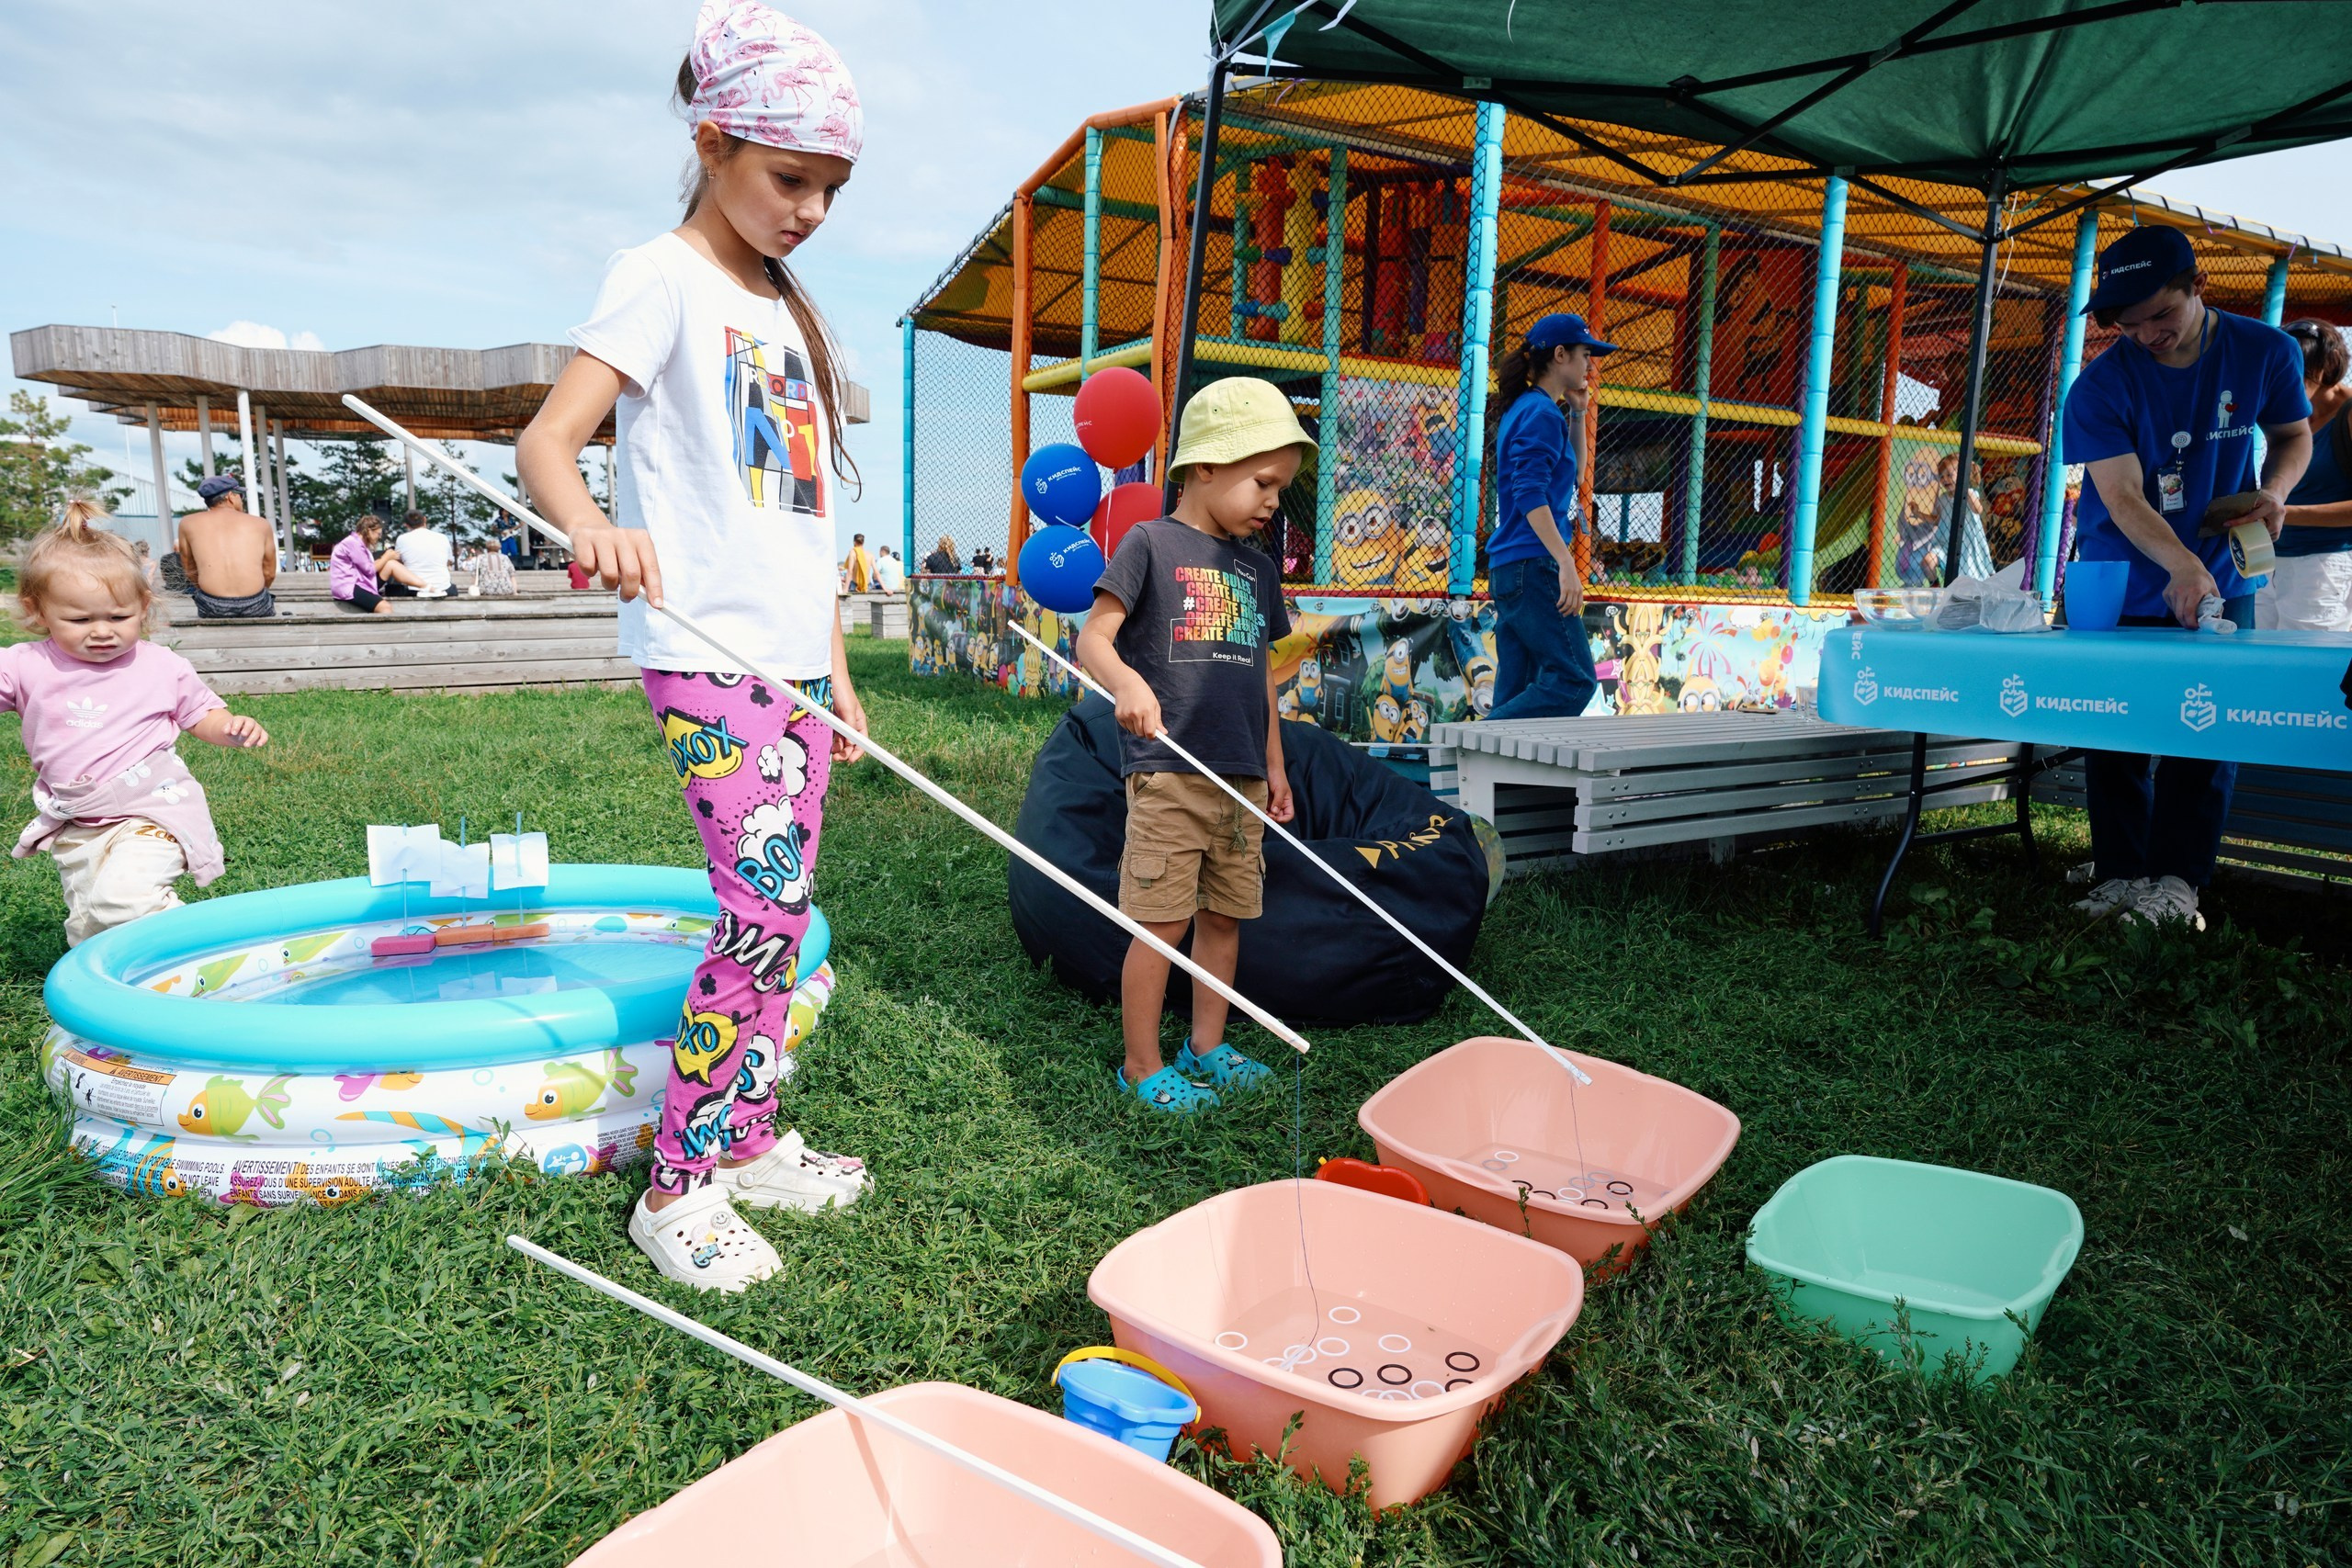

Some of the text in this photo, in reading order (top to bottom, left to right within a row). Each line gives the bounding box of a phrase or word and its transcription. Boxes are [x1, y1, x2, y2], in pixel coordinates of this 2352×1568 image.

[2110, 260, 2152, 275] КИДСПЕЙС
[1175, 566, 1251, 595] CREATE RULES
[1186, 581, 1231, 601] CREATE
[1182, 596, 1239, 616] #CREATE
[1185, 611, 1233, 629] CREATE
[1174, 626, 1258, 649] CREATE RULES
[1851, 630, 1864, 660] ЕЙС
[1213, 651, 1232, 661] Keep
[1237, 655, 1251, 664] Real
[1883, 685, 1960, 703] КИДСПЕЙС
[2035, 695, 2129, 715] КИДСПЕЙС
[65, 719, 104, 729] adidas
[2226, 708, 2348, 730] КИДСПЕЙС
[117, 1068, 165, 1083] AVERTISSEMENT
[147, 1156, 176, 1169] PORTABLE
[175, 1159, 204, 1173] SWIMMING
[203, 1162, 225, 1175] POOLS.
[231, 1159, 301, 1175] AVERTISSEMENT!
[300, 1163, 315, 1175] DES
[314, 1163, 345, 1175] ENFANTS
[345, 1162, 356, 1174] SE
[356, 1162, 376, 1174] SONT
[435, 1155, 468, 1168] PISCINES
[178, 1173, 187, 1184] DO
[187, 1174, 200, 1185] NOT
[200, 1175, 220, 1187] LEAVE
[229, 1176, 277, 1188] ASSUREZ-VOUS
[299, 1177, 344, 1188] SUPERVISION
[344, 1176, 370, 1187] ADULTE
[230, 1188, 258, 1199] ENFANTS
[258, 1190, 275, 1199] SANS
